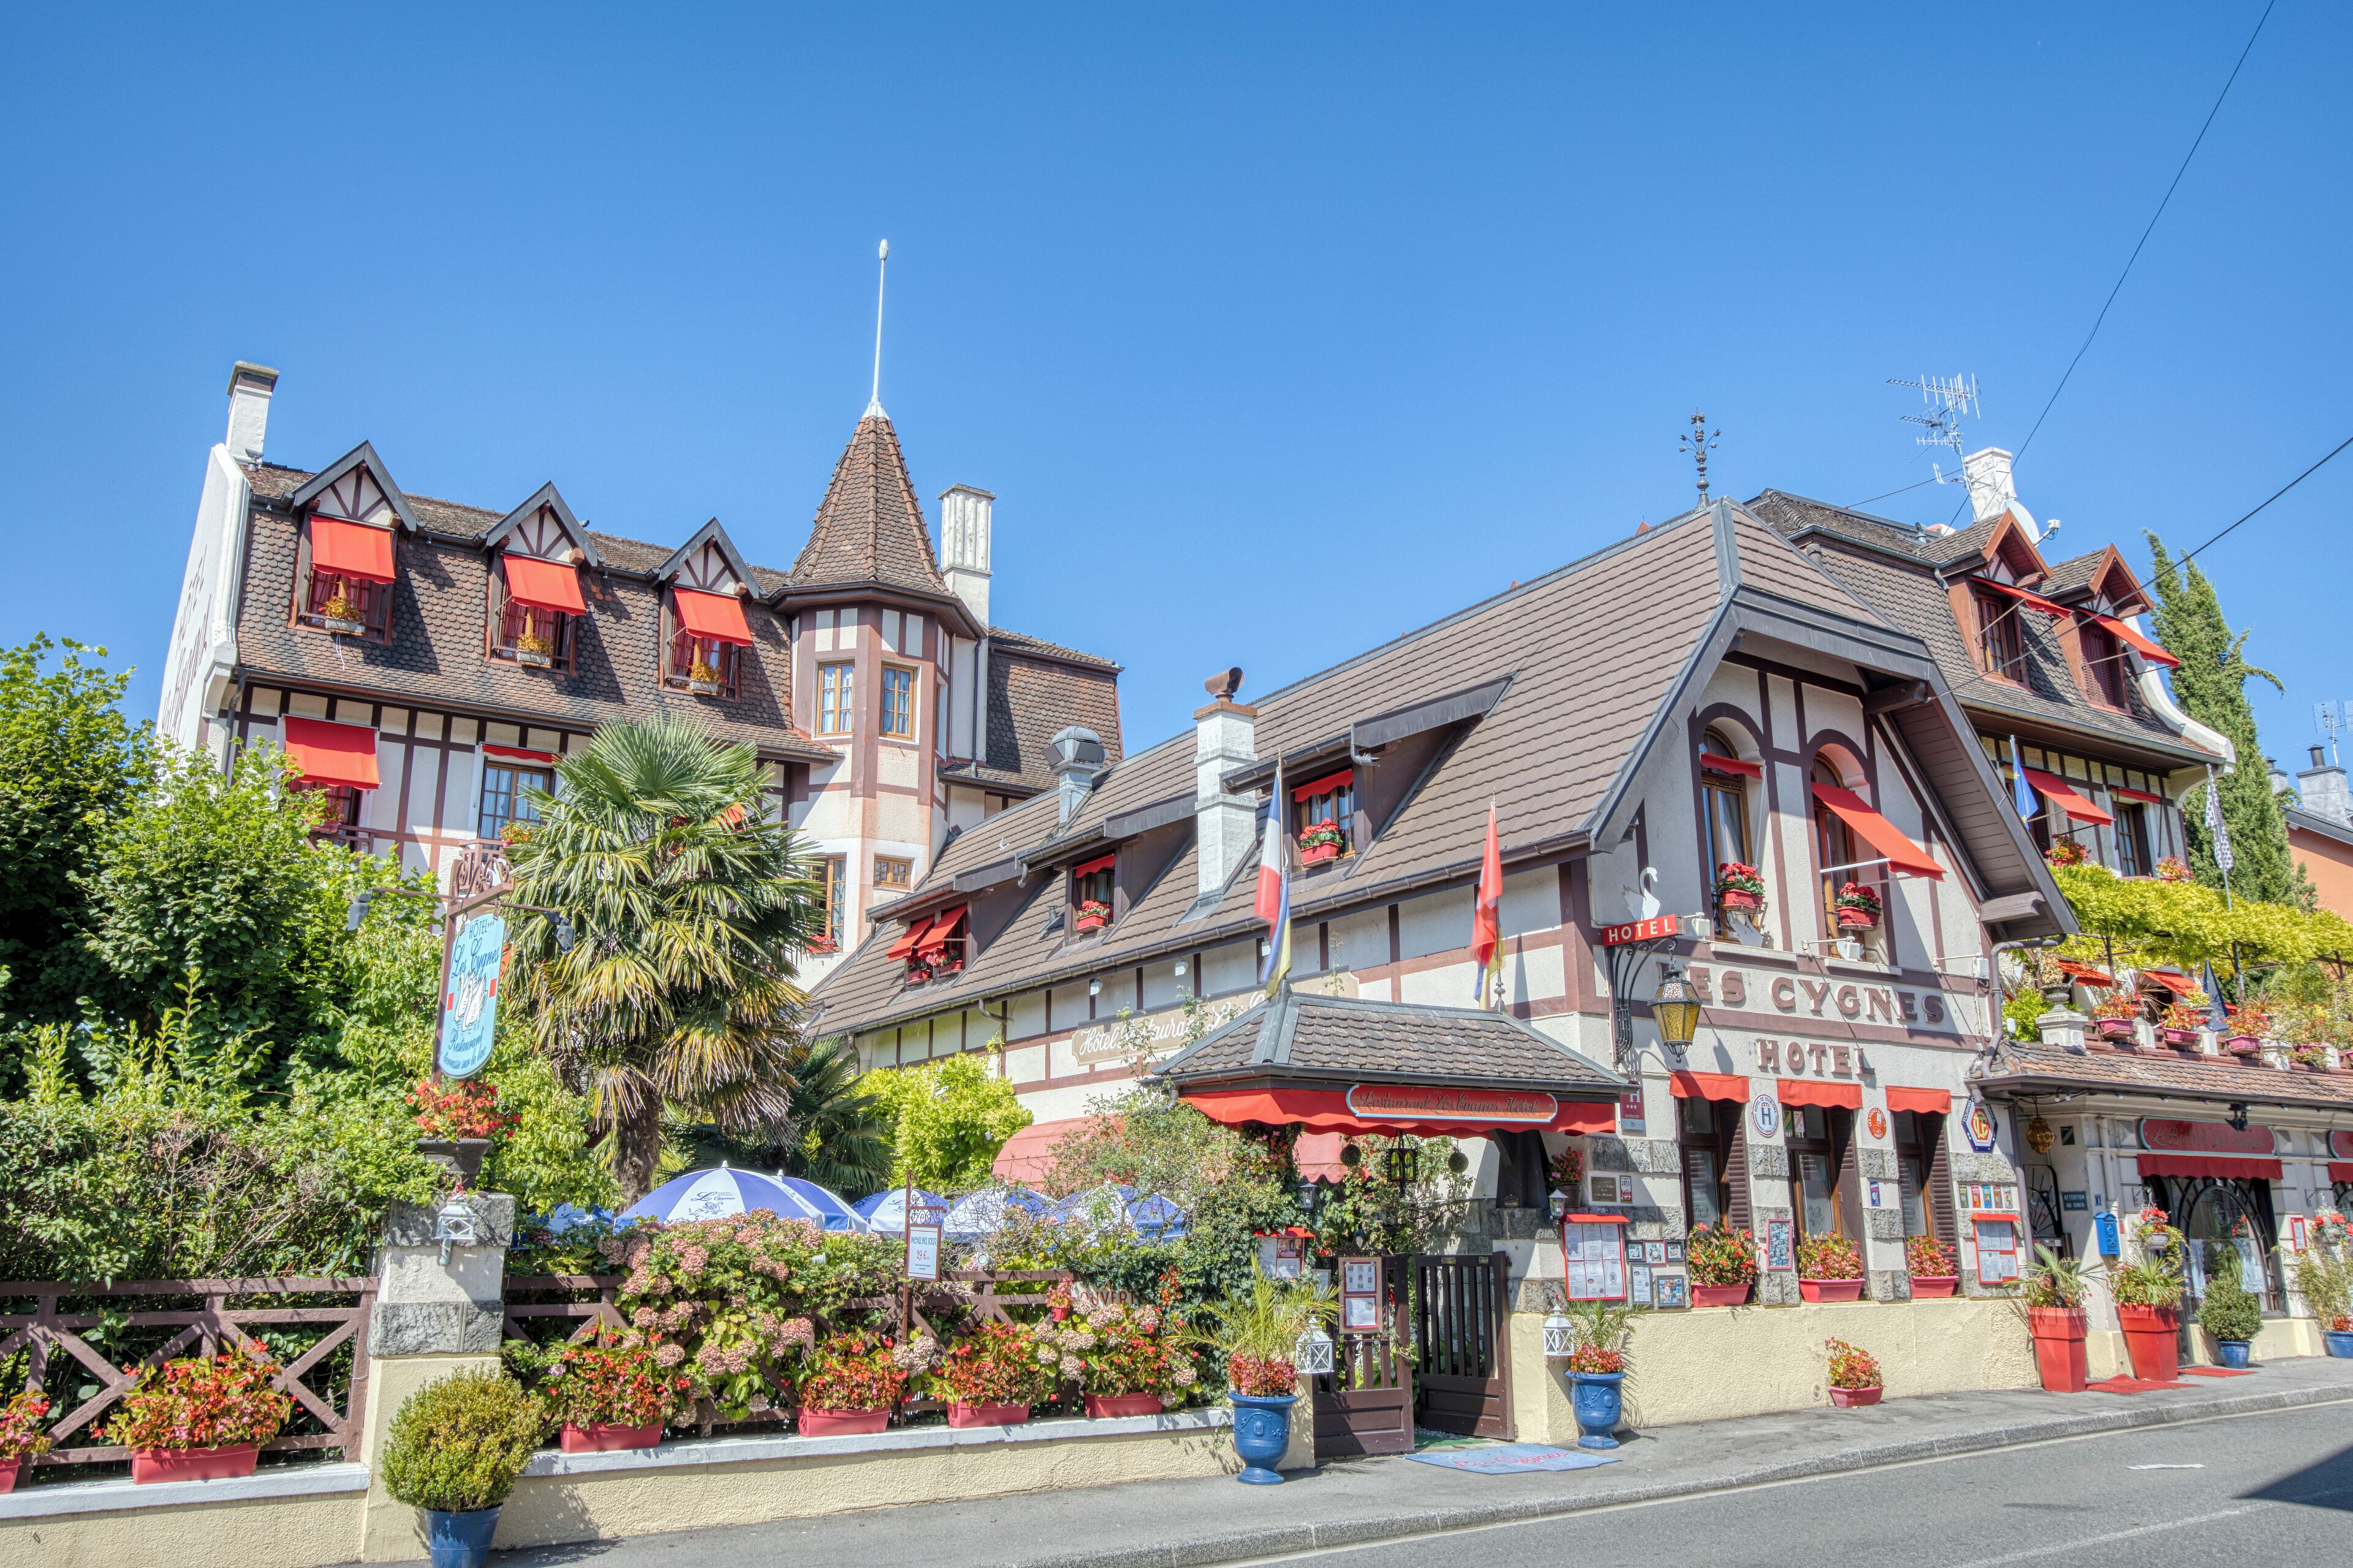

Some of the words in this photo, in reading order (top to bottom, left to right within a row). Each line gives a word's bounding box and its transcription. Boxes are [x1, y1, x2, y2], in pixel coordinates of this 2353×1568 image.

[469, 918, 487, 939] HÔTEL
[1608, 918, 1672, 943] HOTEL
[451, 944, 467, 979] Les
[471, 937, 500, 982] Cygnes
[1771, 977, 1945, 1024] CYGNES
[1079, 1024, 1120, 1056] Hôtel
[1756, 1038, 1876, 1075] HOTEL
[1357, 1089, 1431, 1111] Restaurant
[1430, 1094, 1454, 1115] Les
[1456, 1092, 1499, 1116] Cygnes
[1504, 1097, 1539, 1115] Hôtel
[1963, 1100, 1972, 1123] TOURING
[1760, 1107, 1773, 1126] H
